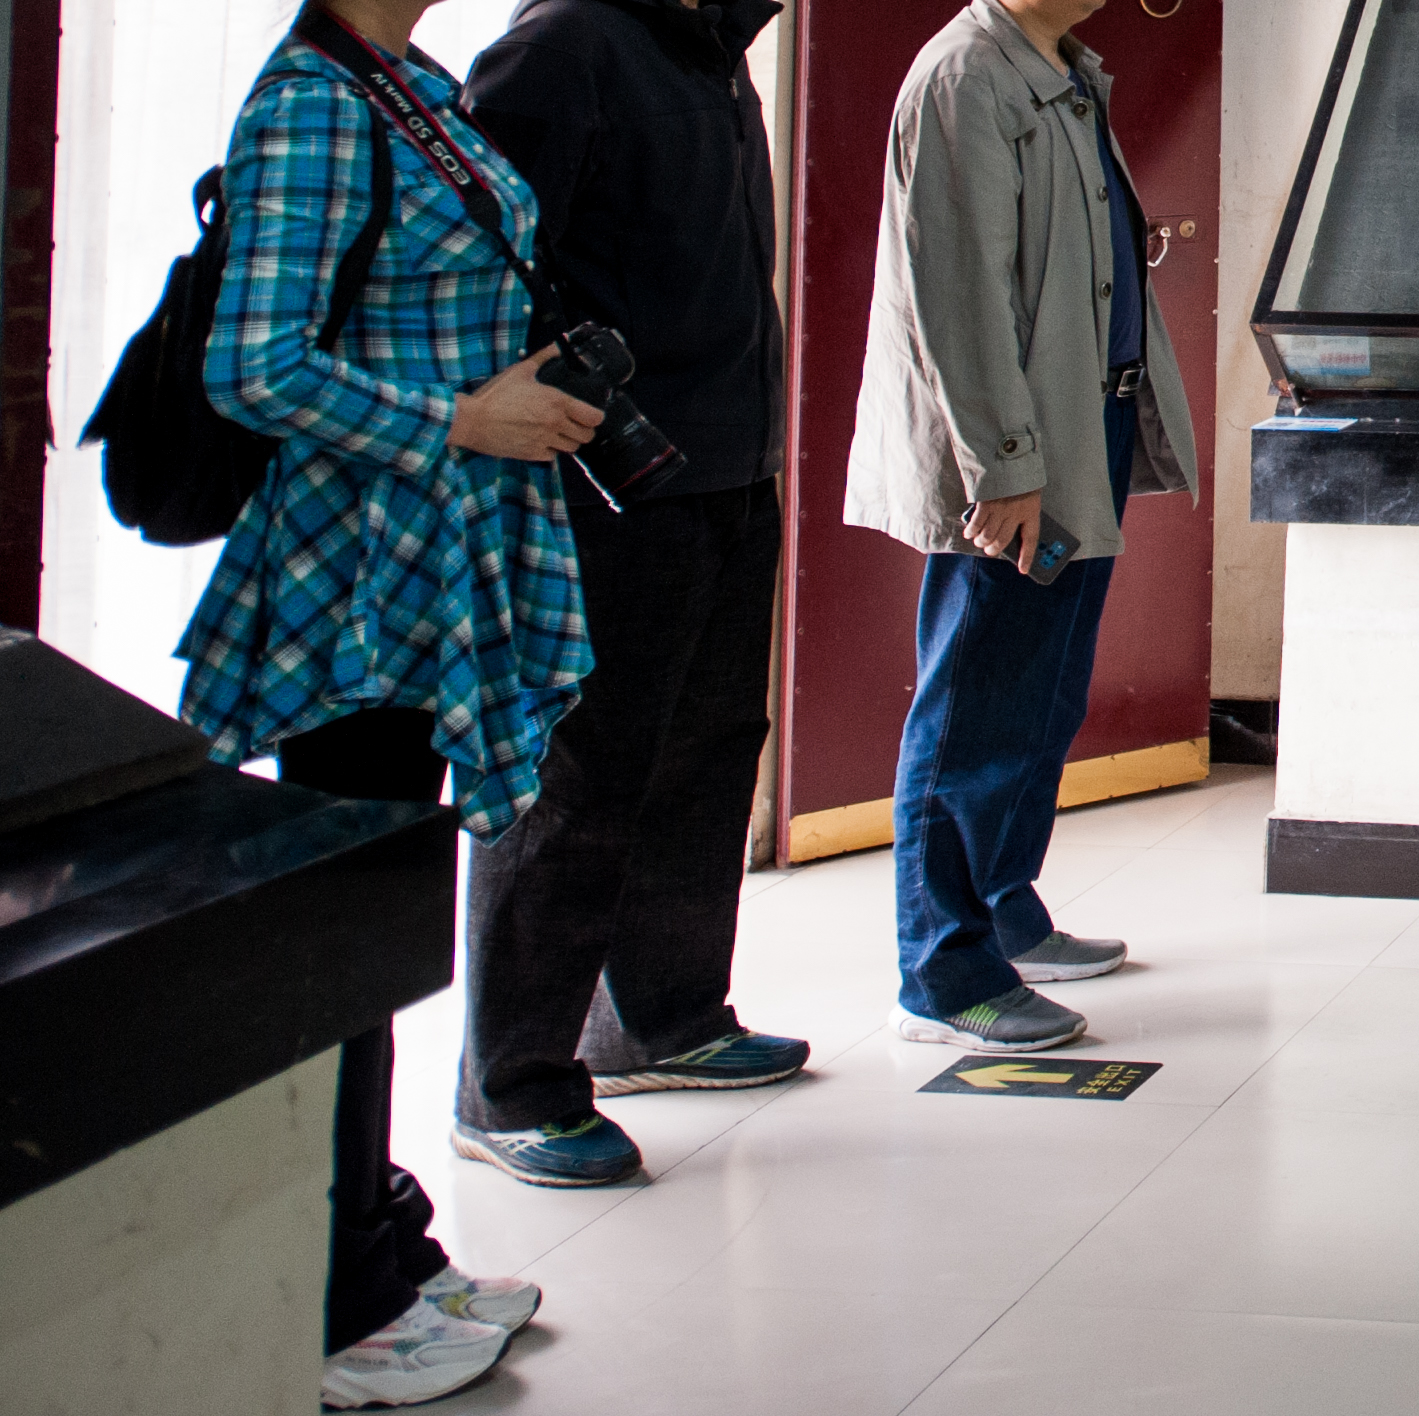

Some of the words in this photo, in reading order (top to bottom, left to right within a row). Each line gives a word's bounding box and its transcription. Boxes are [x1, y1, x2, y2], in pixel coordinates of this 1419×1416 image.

[370, 73, 388, 85] IV
[384, 84, 413, 113] Mark
[407, 116, 434, 140] 5D
[428, 141, 472, 186] EOS
[1106, 1068, 1141, 1093] EXIT
